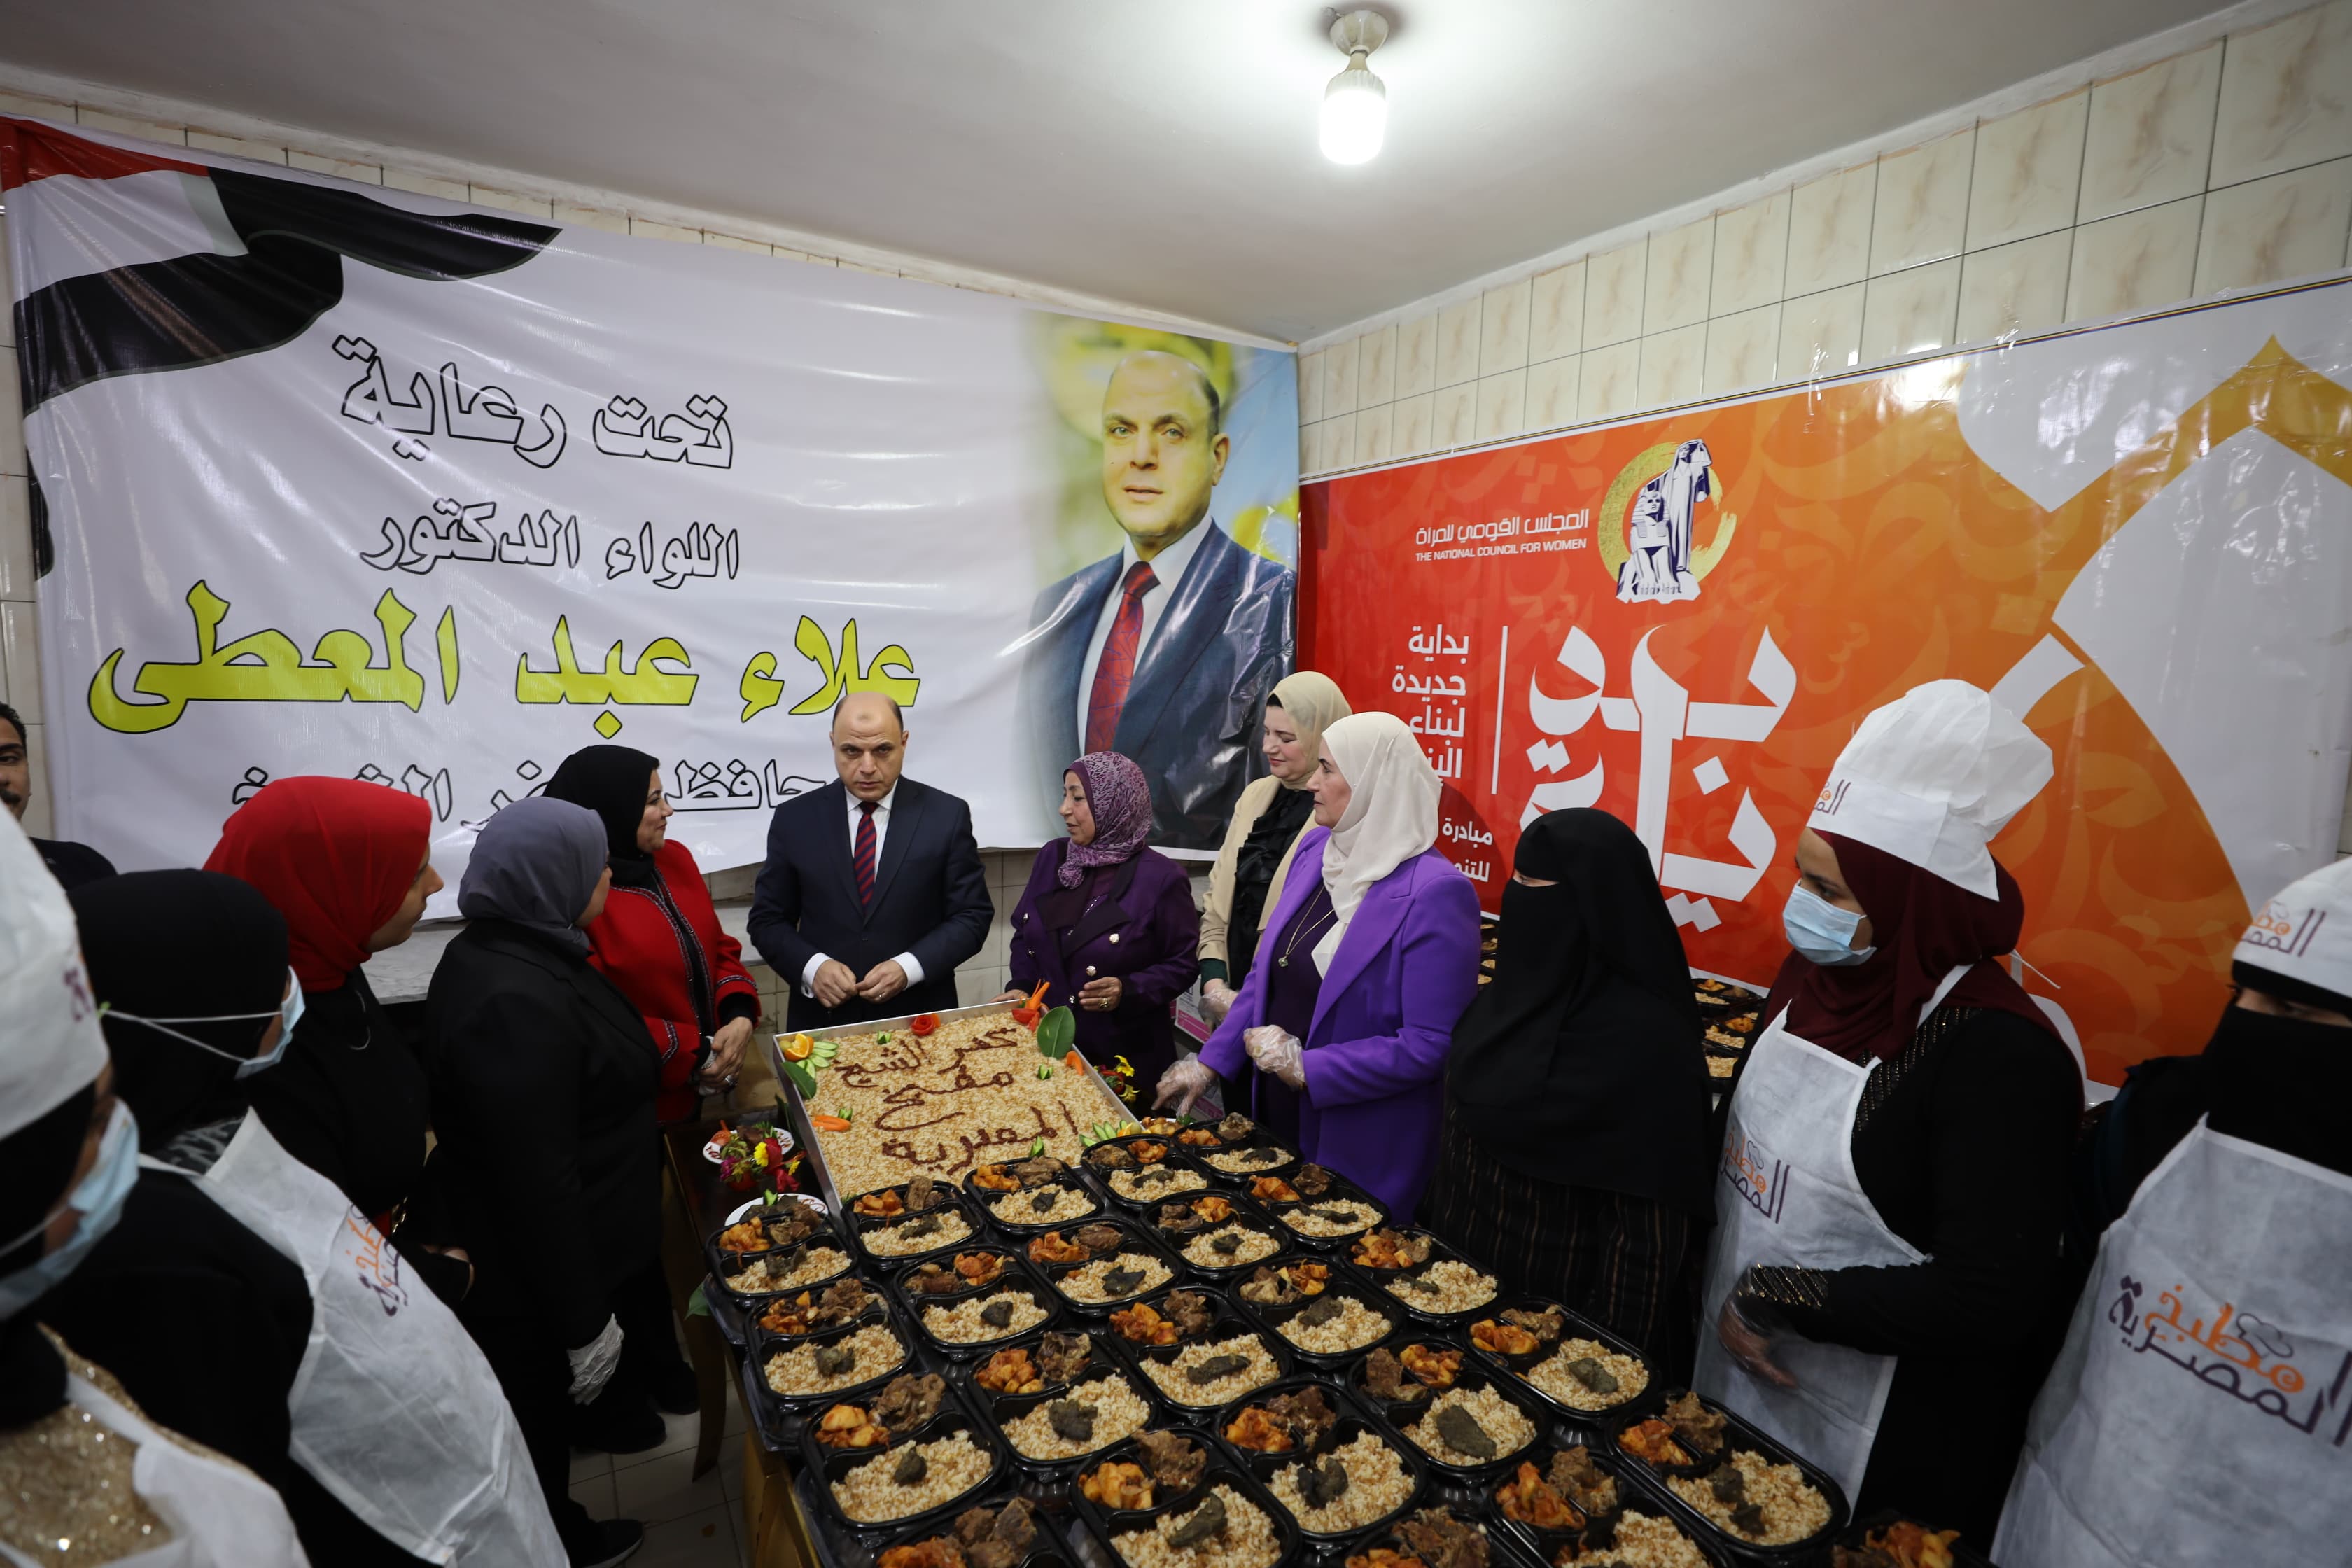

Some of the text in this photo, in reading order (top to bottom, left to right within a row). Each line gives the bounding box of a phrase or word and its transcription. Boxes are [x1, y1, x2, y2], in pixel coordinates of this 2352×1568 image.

[332, 334, 733, 469] تحت رعاية
[1457, 516, 1520, 543] القومي
[1523, 508, 1590, 535] المجلس
[359, 498, 739, 589] اللواء الدكتور
[1415, 538, 1588, 561] THE NATIONAL COUNCIL FOR WOMEN
[87, 578, 921, 740] علاء عبد المعطى
[1408, 623, 1470, 664] بداية
[1392, 664, 1466, 706] جديدة
[1409, 704, 1466, 746] لبناء
[665, 758, 827, 812] حافظ
[1442, 817, 1494, 848] مبادرة
[833, 1039, 932, 1089] الشيخ
[2143, 1283, 2305, 1394] مطبخ
